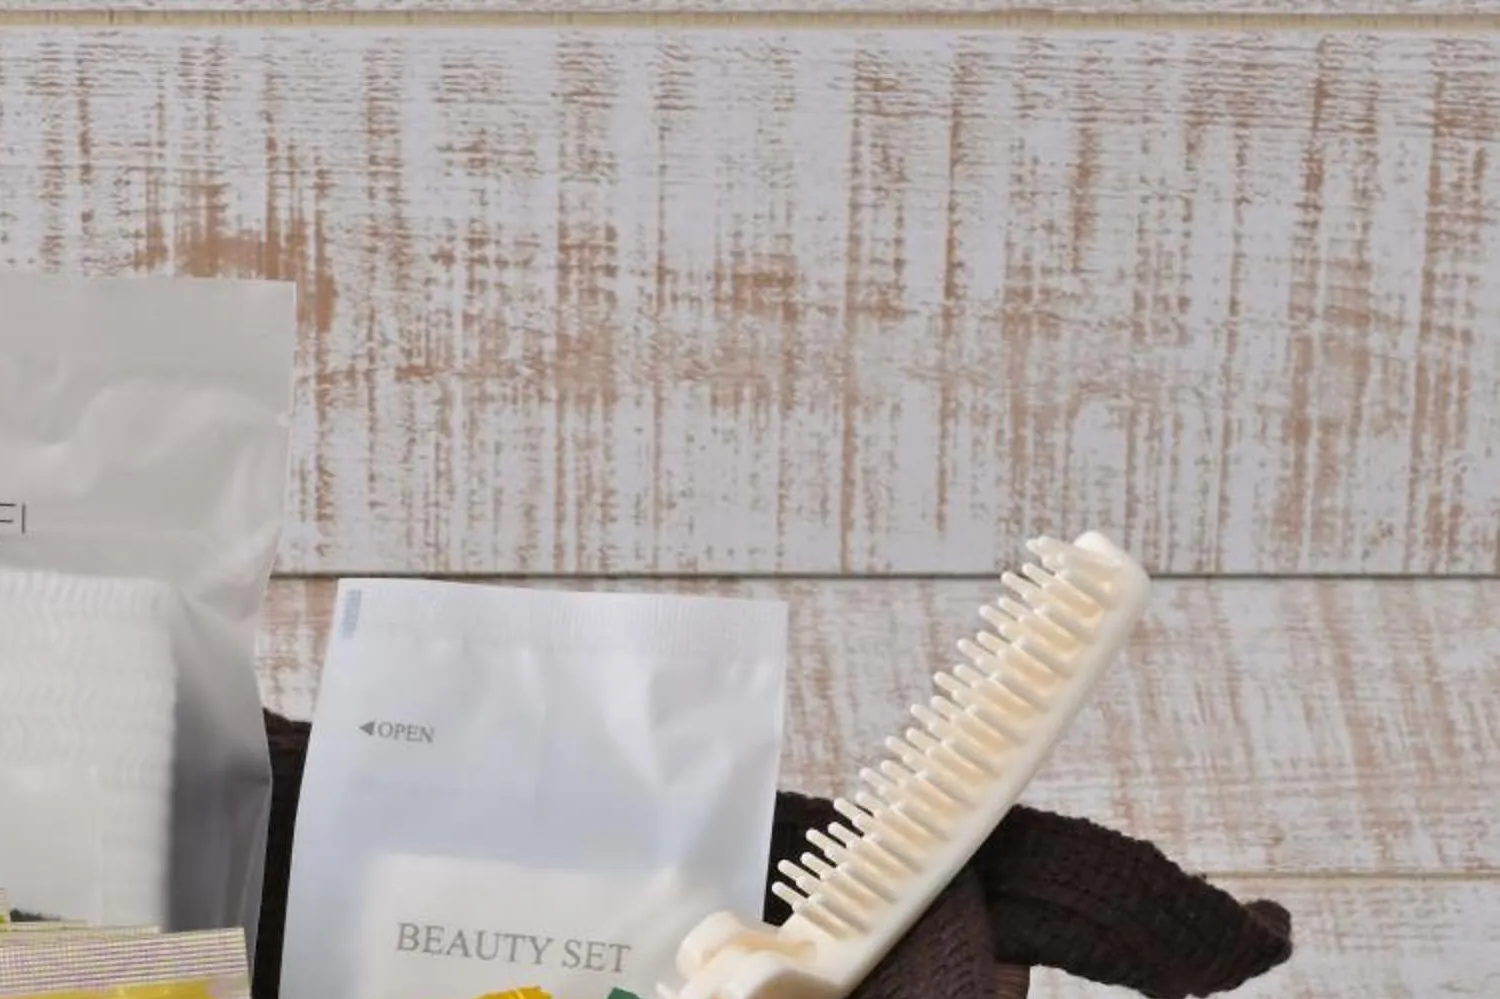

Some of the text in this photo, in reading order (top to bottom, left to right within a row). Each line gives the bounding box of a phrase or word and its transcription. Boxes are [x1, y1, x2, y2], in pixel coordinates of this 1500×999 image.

[377, 721, 435, 743] OPEN
[396, 921, 632, 973] BEAUTY SET
